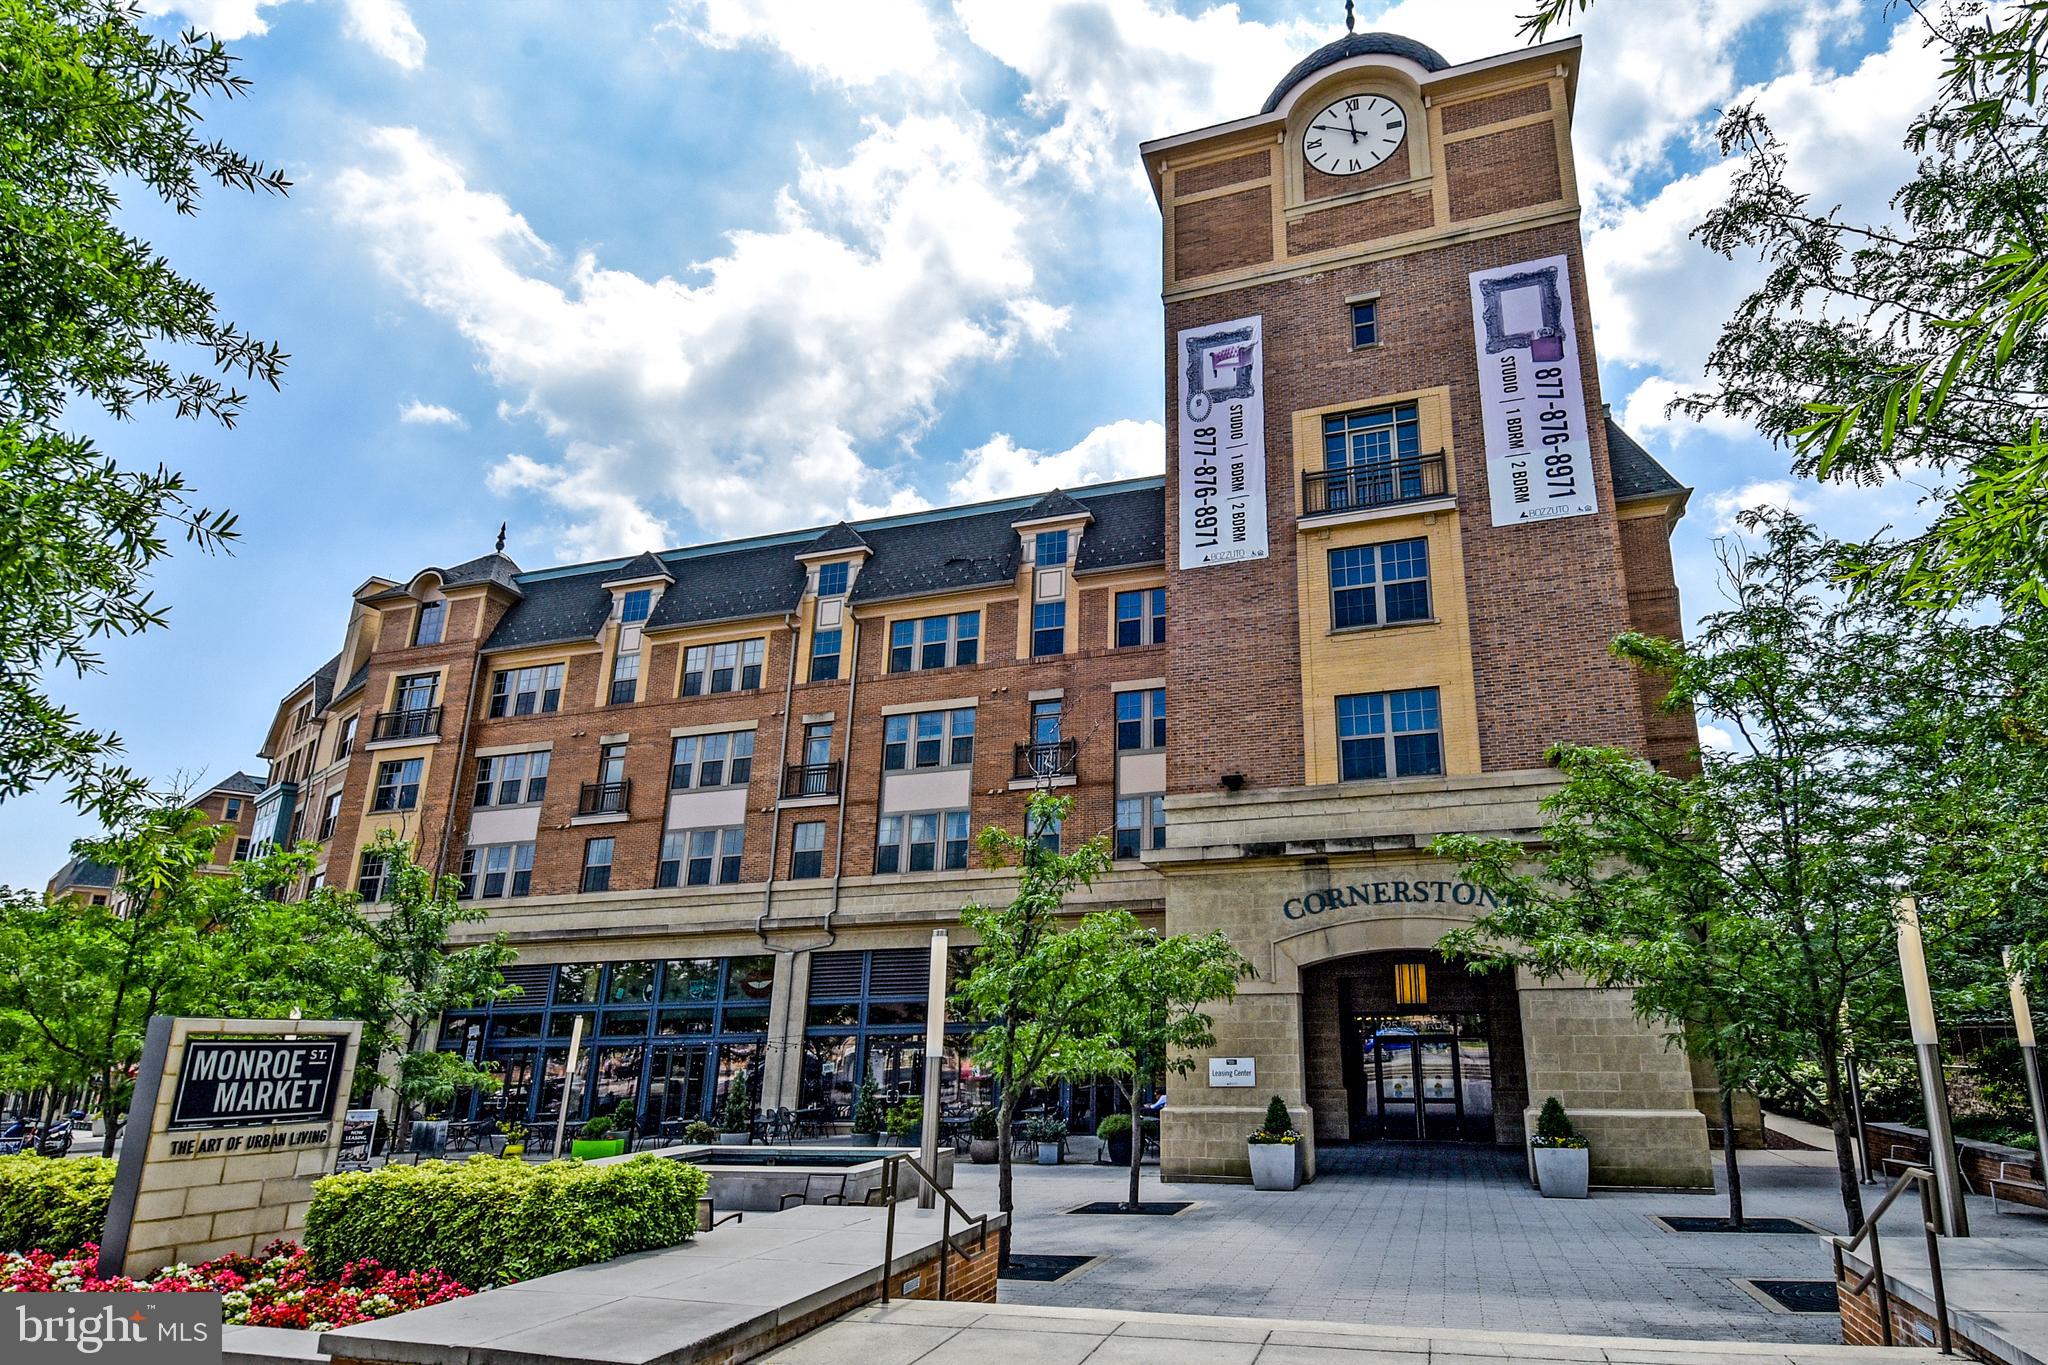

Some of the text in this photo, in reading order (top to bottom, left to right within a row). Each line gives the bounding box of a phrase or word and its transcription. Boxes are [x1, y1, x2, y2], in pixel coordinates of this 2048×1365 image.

[1500, 355, 1518, 394] STUDIO
[1230, 403, 1243, 440] STUDIO
[1506, 417, 1525, 450] BDRM
[1534, 367, 1576, 499] 877-876-8971
[1231, 462, 1245, 493] BDRM
[1511, 461, 1526, 469] 2
[1193, 426, 1218, 548] 877-876-8971
[1512, 471, 1530, 504] BDRM
[1232, 502, 1245, 510] 2
[1529, 504, 1570, 517] BOZZUTO
[1232, 512, 1246, 543] BDRM
[1211, 549, 1246, 561] BOZZUTO
[1283, 881, 1514, 920] CORNERSTON
[191, 1049, 328, 1081] MONROE ST.
[1212, 1069, 1252, 1078] Leasing Center
[212, 1079, 322, 1113] MARKET
[171, 1129, 328, 1156] THE ART OF URBAN LIVING
